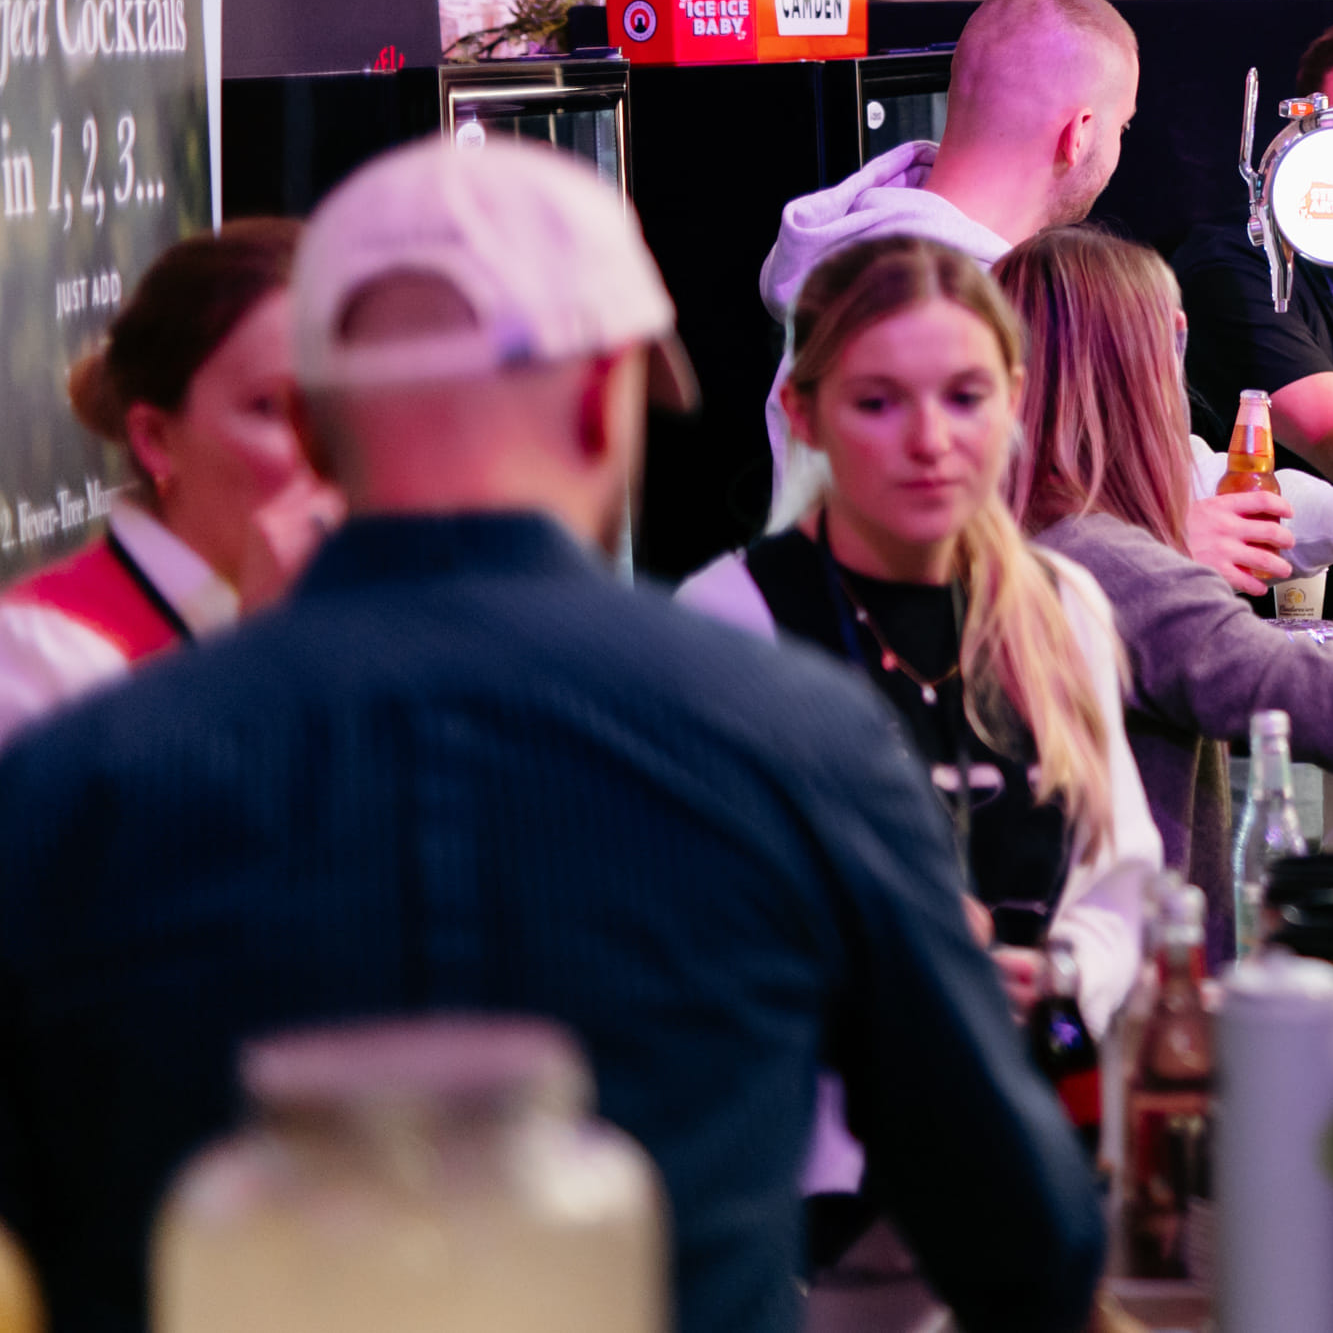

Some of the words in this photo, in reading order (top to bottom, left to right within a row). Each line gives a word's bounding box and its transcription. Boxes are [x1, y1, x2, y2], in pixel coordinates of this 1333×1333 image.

[720, 0, 749, 17] ICE
[1, 121, 36, 216] in
[56, 276, 87, 319] JUST
[92, 271, 121, 307] ADD
